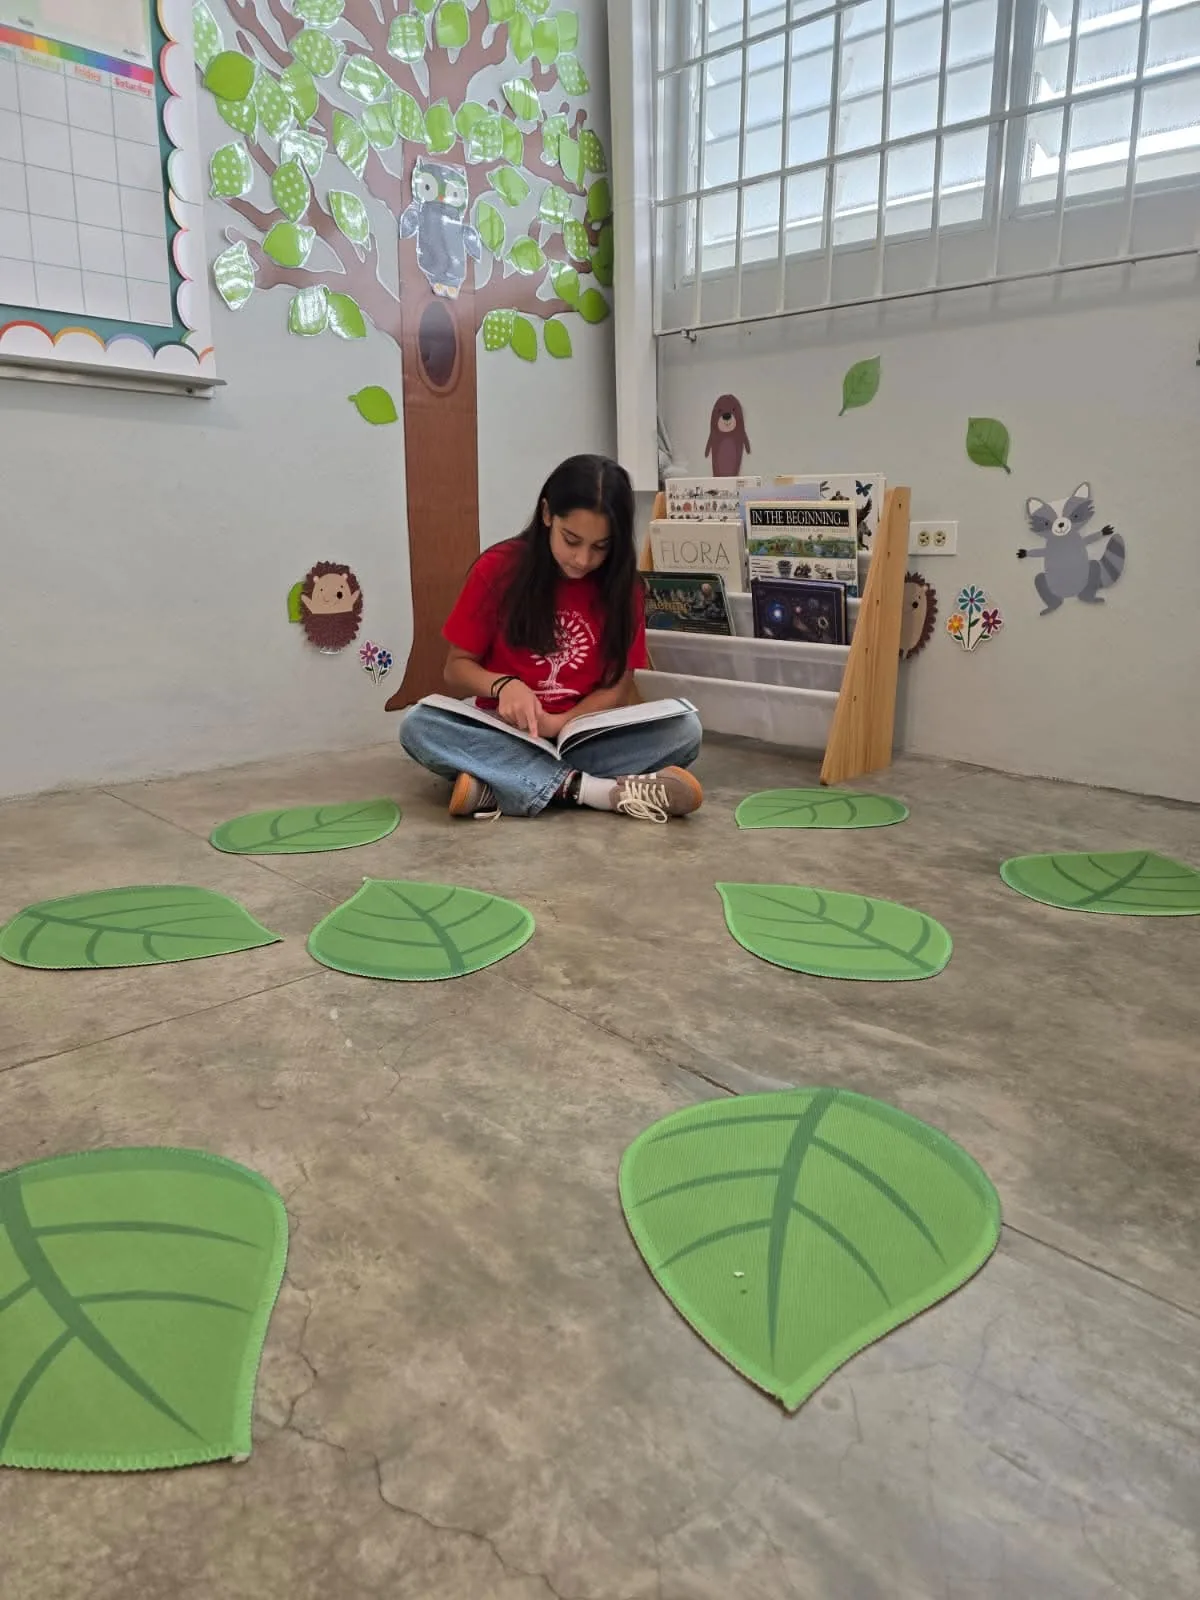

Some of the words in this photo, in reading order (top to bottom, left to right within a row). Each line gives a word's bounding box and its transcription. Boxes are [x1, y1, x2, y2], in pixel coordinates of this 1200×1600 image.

[114, 76, 152, 97] Saturday
[751, 510, 762, 525] IN
[763, 510, 784, 525] THE
[661, 541, 730, 565] FLORA
